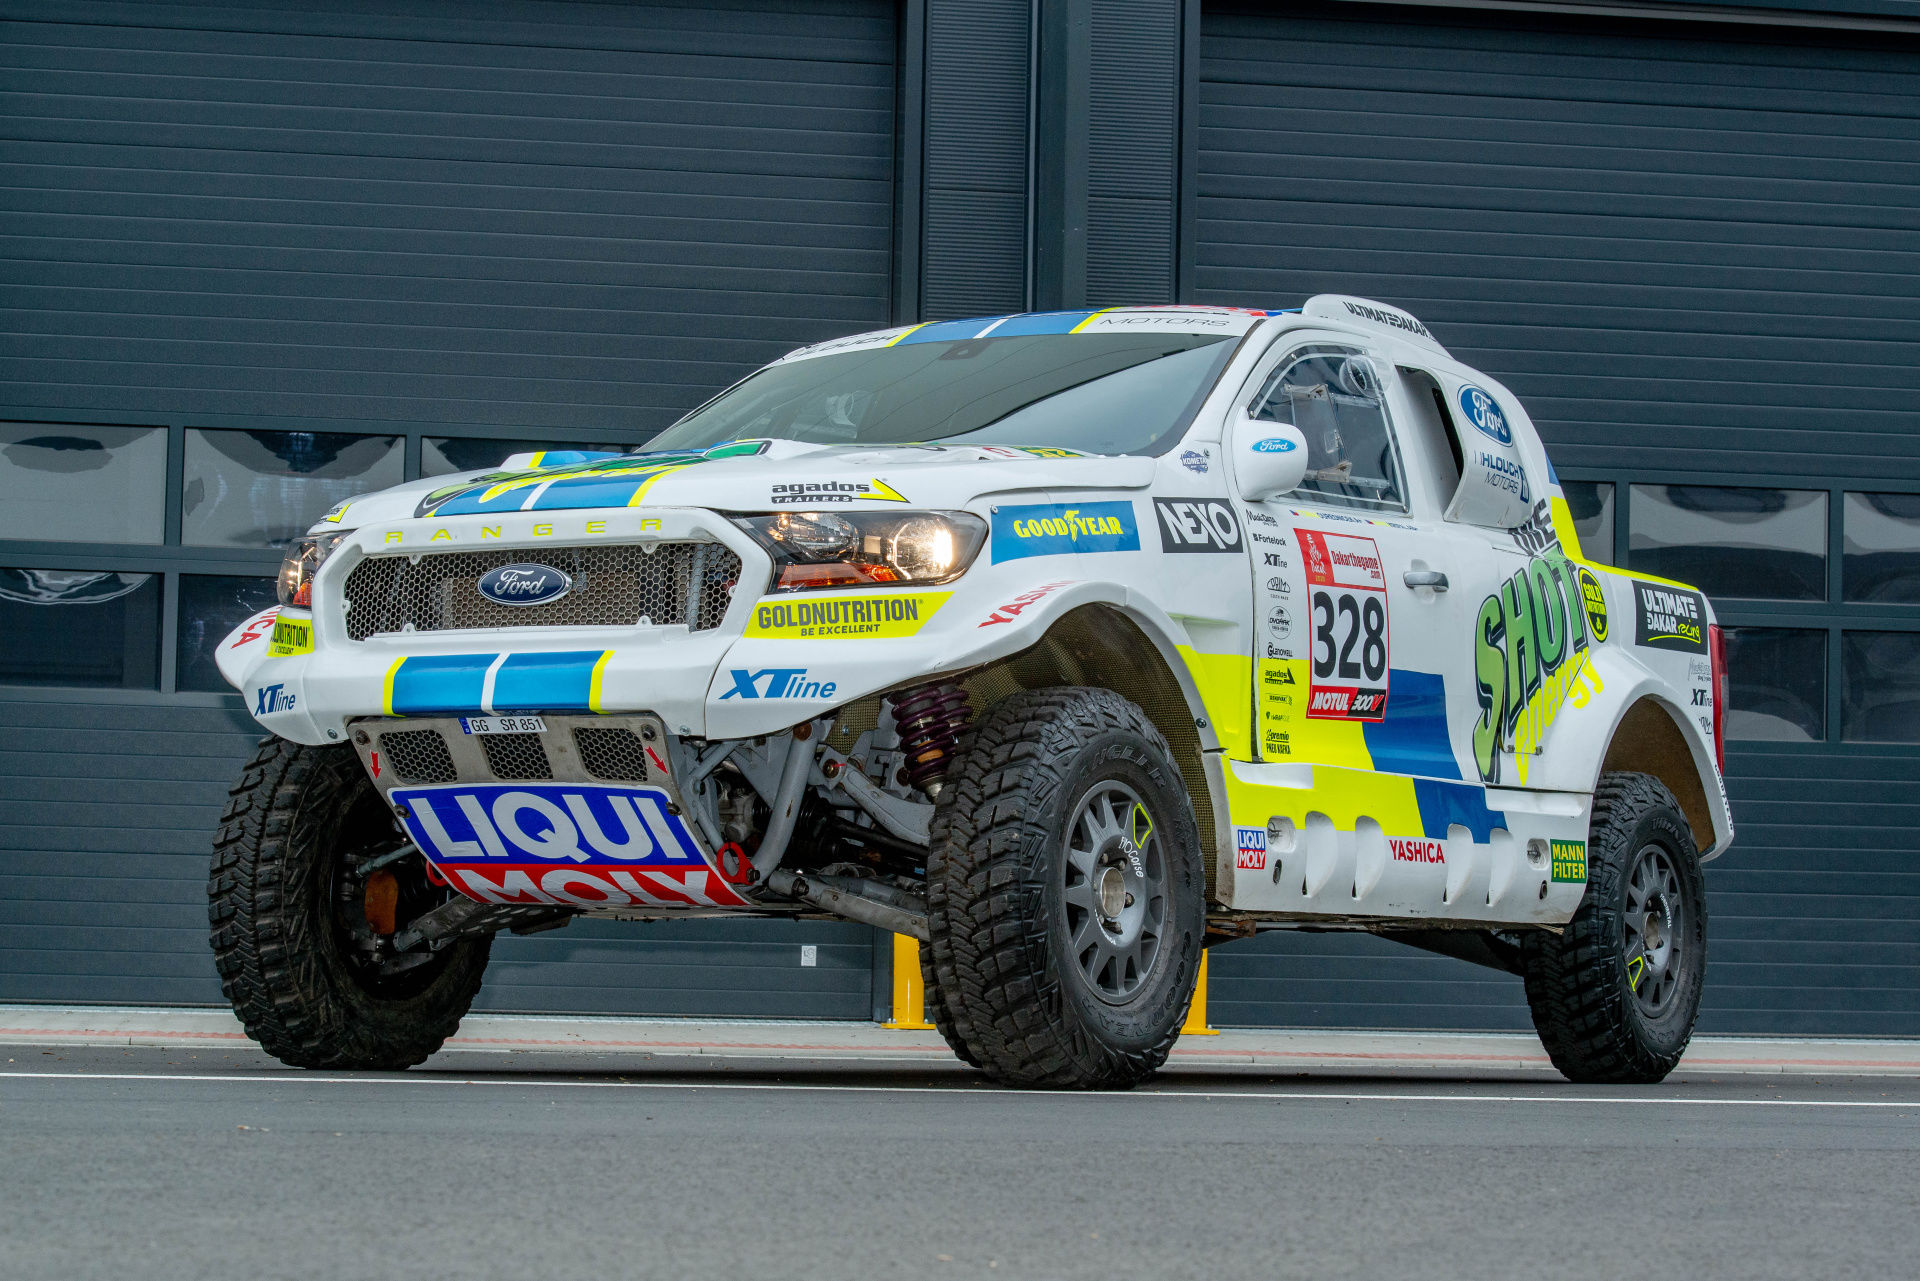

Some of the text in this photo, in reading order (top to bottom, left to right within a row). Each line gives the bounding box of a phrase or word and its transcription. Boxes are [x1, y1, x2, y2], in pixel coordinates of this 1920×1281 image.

[1100, 317, 1229, 327] MOTORS
[1472, 391, 1508, 438] Ford
[1260, 439, 1288, 451] Ford
[1482, 452, 1520, 480] HLOUCH
[772, 481, 870, 494] agados
[1485, 472, 1519, 494] MOTORS
[774, 496, 851, 504] TRAILERS
[385, 518, 662, 544] RANGER
[1013, 512, 1123, 539] GOODYEAR
[1157, 502, 1239, 550] NEXO
[1258, 534, 1287, 546] Fortelock
[1264, 552, 1288, 568] XTline
[1331, 550, 1379, 570] Dakarthegame
[494, 570, 545, 596] Ford
[758, 599, 919, 629] GOLDNUTRITION
[1641, 588, 1698, 619] ULTIMATE
[801, 624, 880, 636] BE EXCELLENT
[1647, 612, 1677, 634] DAKAR
[1314, 591, 1386, 681] 328
[1473, 540, 1589, 784] SHOT
[719, 669, 837, 698] XTline
[1265, 670, 1288, 678] agados
[254, 683, 296, 717] XTline
[1311, 691, 1350, 711] MOTUL
[1351, 694, 1385, 712] 300V
[471, 718, 543, 732] GG SR 851
[1515, 647, 1604, 787] energy
[407, 791, 688, 864] LIQUI
[1238, 831, 1265, 849] LIQUI
[1238, 850, 1266, 867] MOLY
[1389, 839, 1446, 864] YASHICA
[1551, 843, 1585, 861] MANN
[1553, 861, 1585, 878] FILTER
[454, 869, 721, 905] MOLY
